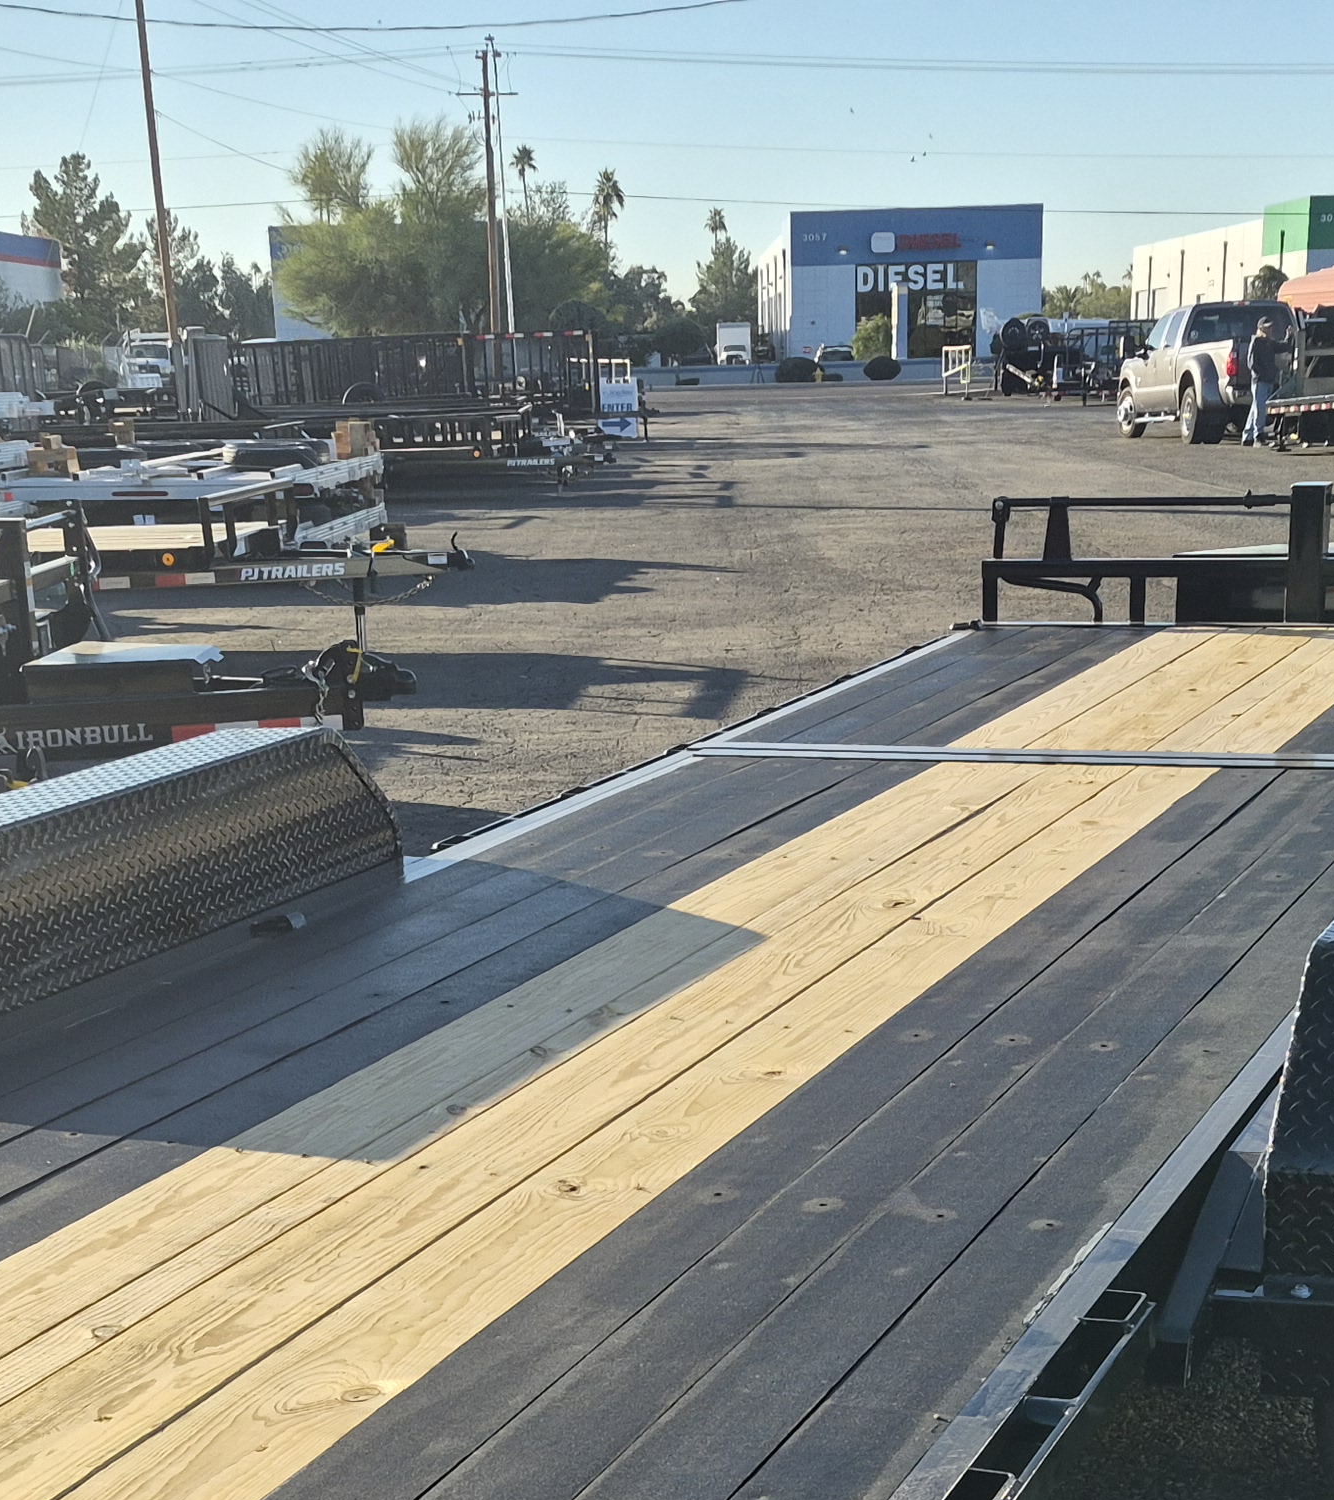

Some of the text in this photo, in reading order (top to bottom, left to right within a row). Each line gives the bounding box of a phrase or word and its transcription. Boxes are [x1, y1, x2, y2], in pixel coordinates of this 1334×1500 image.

[802, 233, 827, 242] 3057
[857, 263, 964, 292] DIESEL
[602, 403, 633, 412] ENTER
[15, 723, 154, 750] IRONBULL
